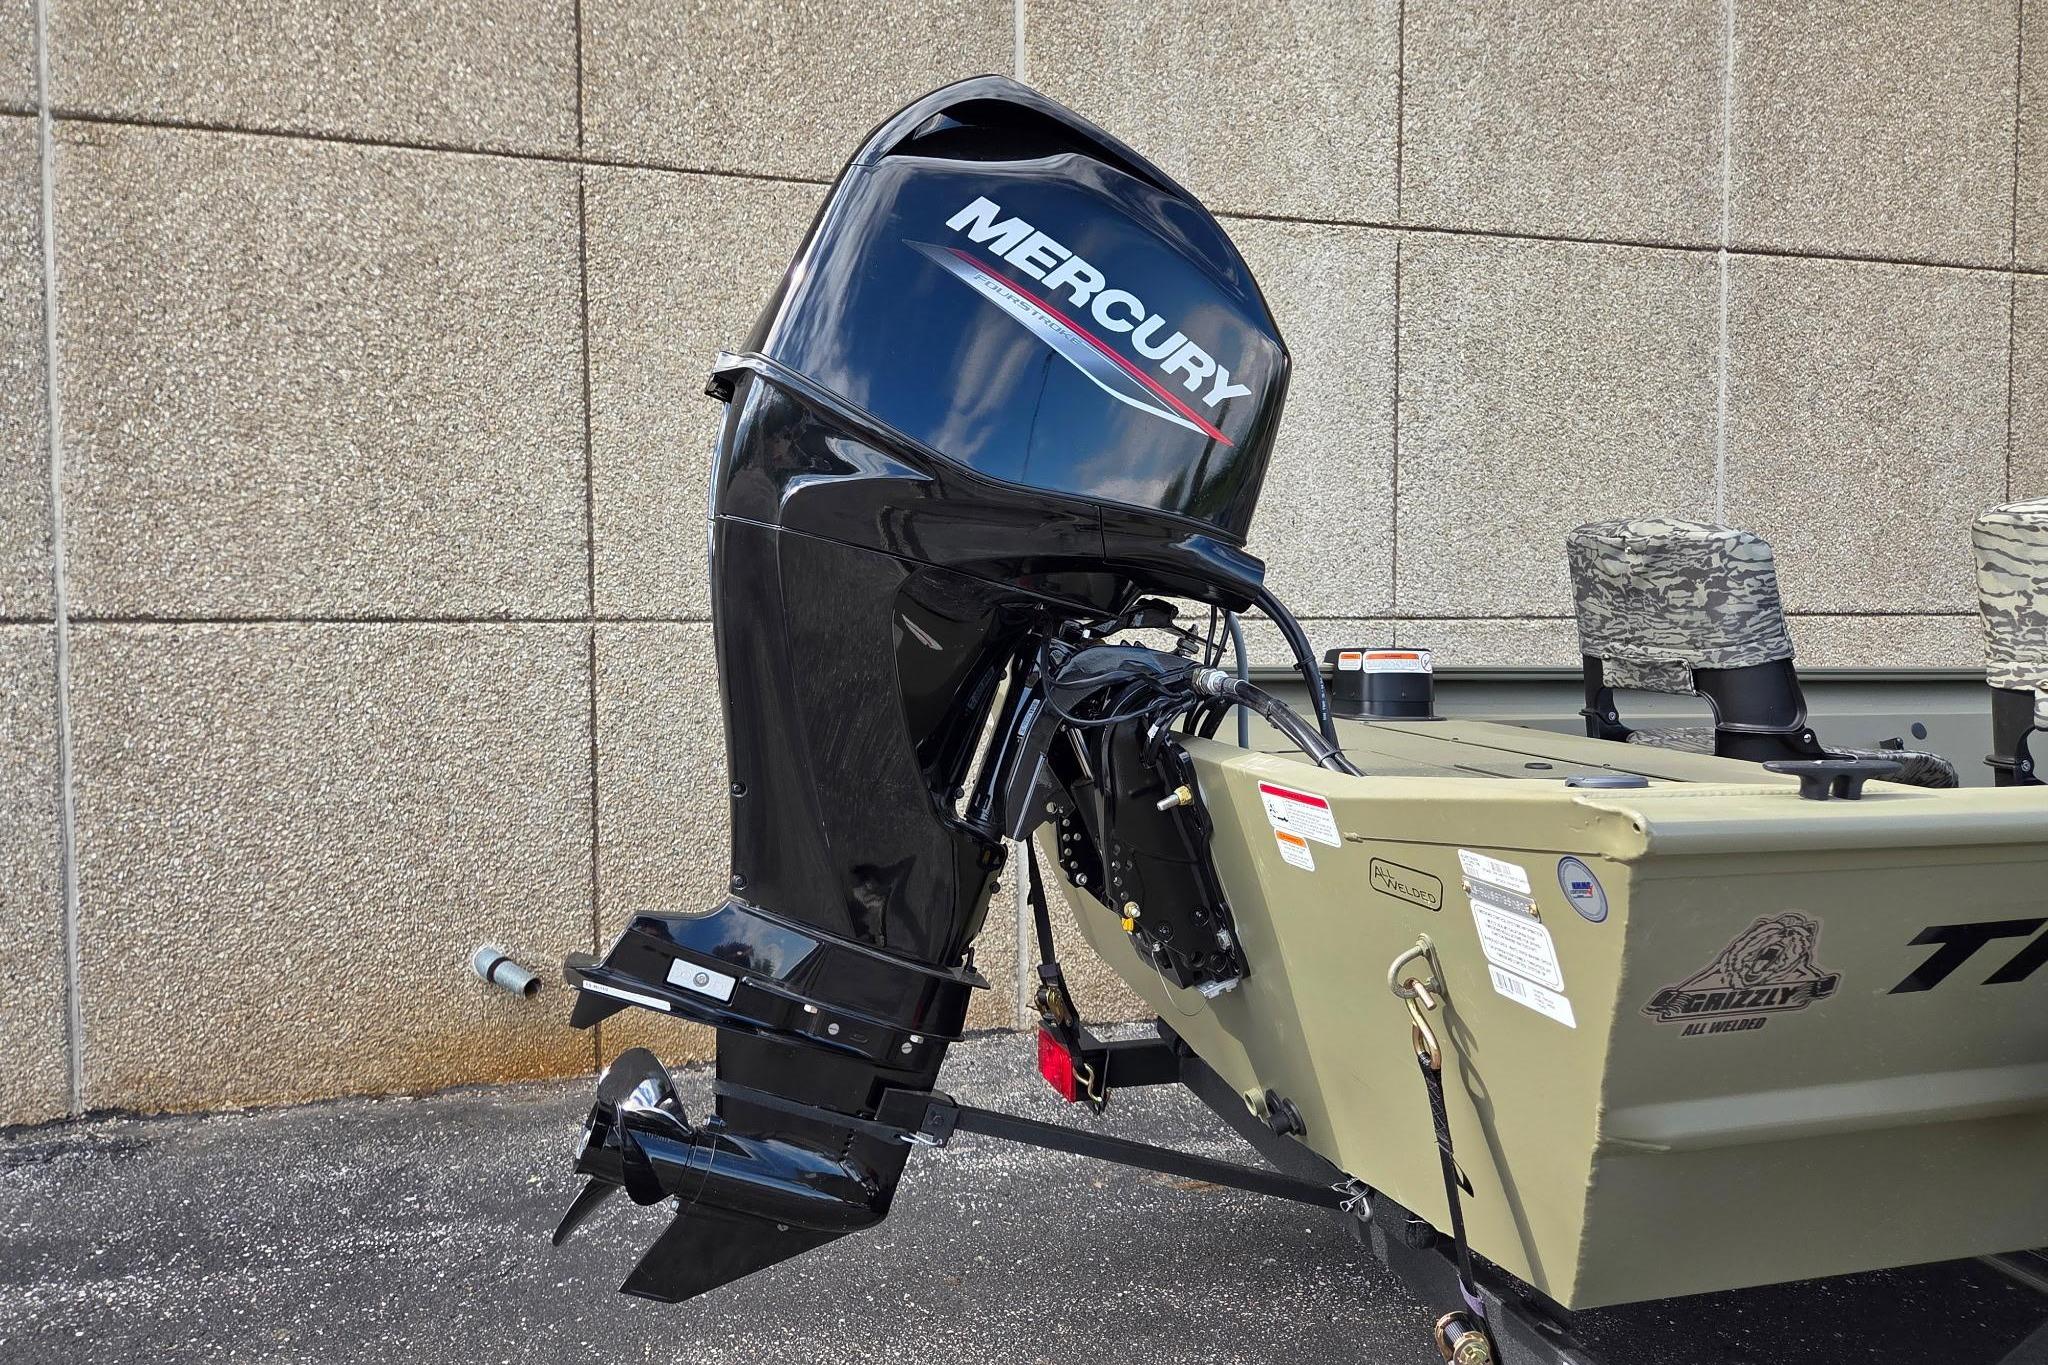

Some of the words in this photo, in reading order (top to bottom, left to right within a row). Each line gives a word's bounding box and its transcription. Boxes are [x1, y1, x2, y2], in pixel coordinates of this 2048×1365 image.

[946, 195, 1252, 408] MERCURY
[974, 273, 1080, 345] FOURSTROKE
[1382, 877, 1436, 903] WELDED
[1683, 986, 1802, 1014] GRIZZLY
[1681, 1023, 1705, 1036] ALL
[1708, 1017, 1767, 1034] WELDED
